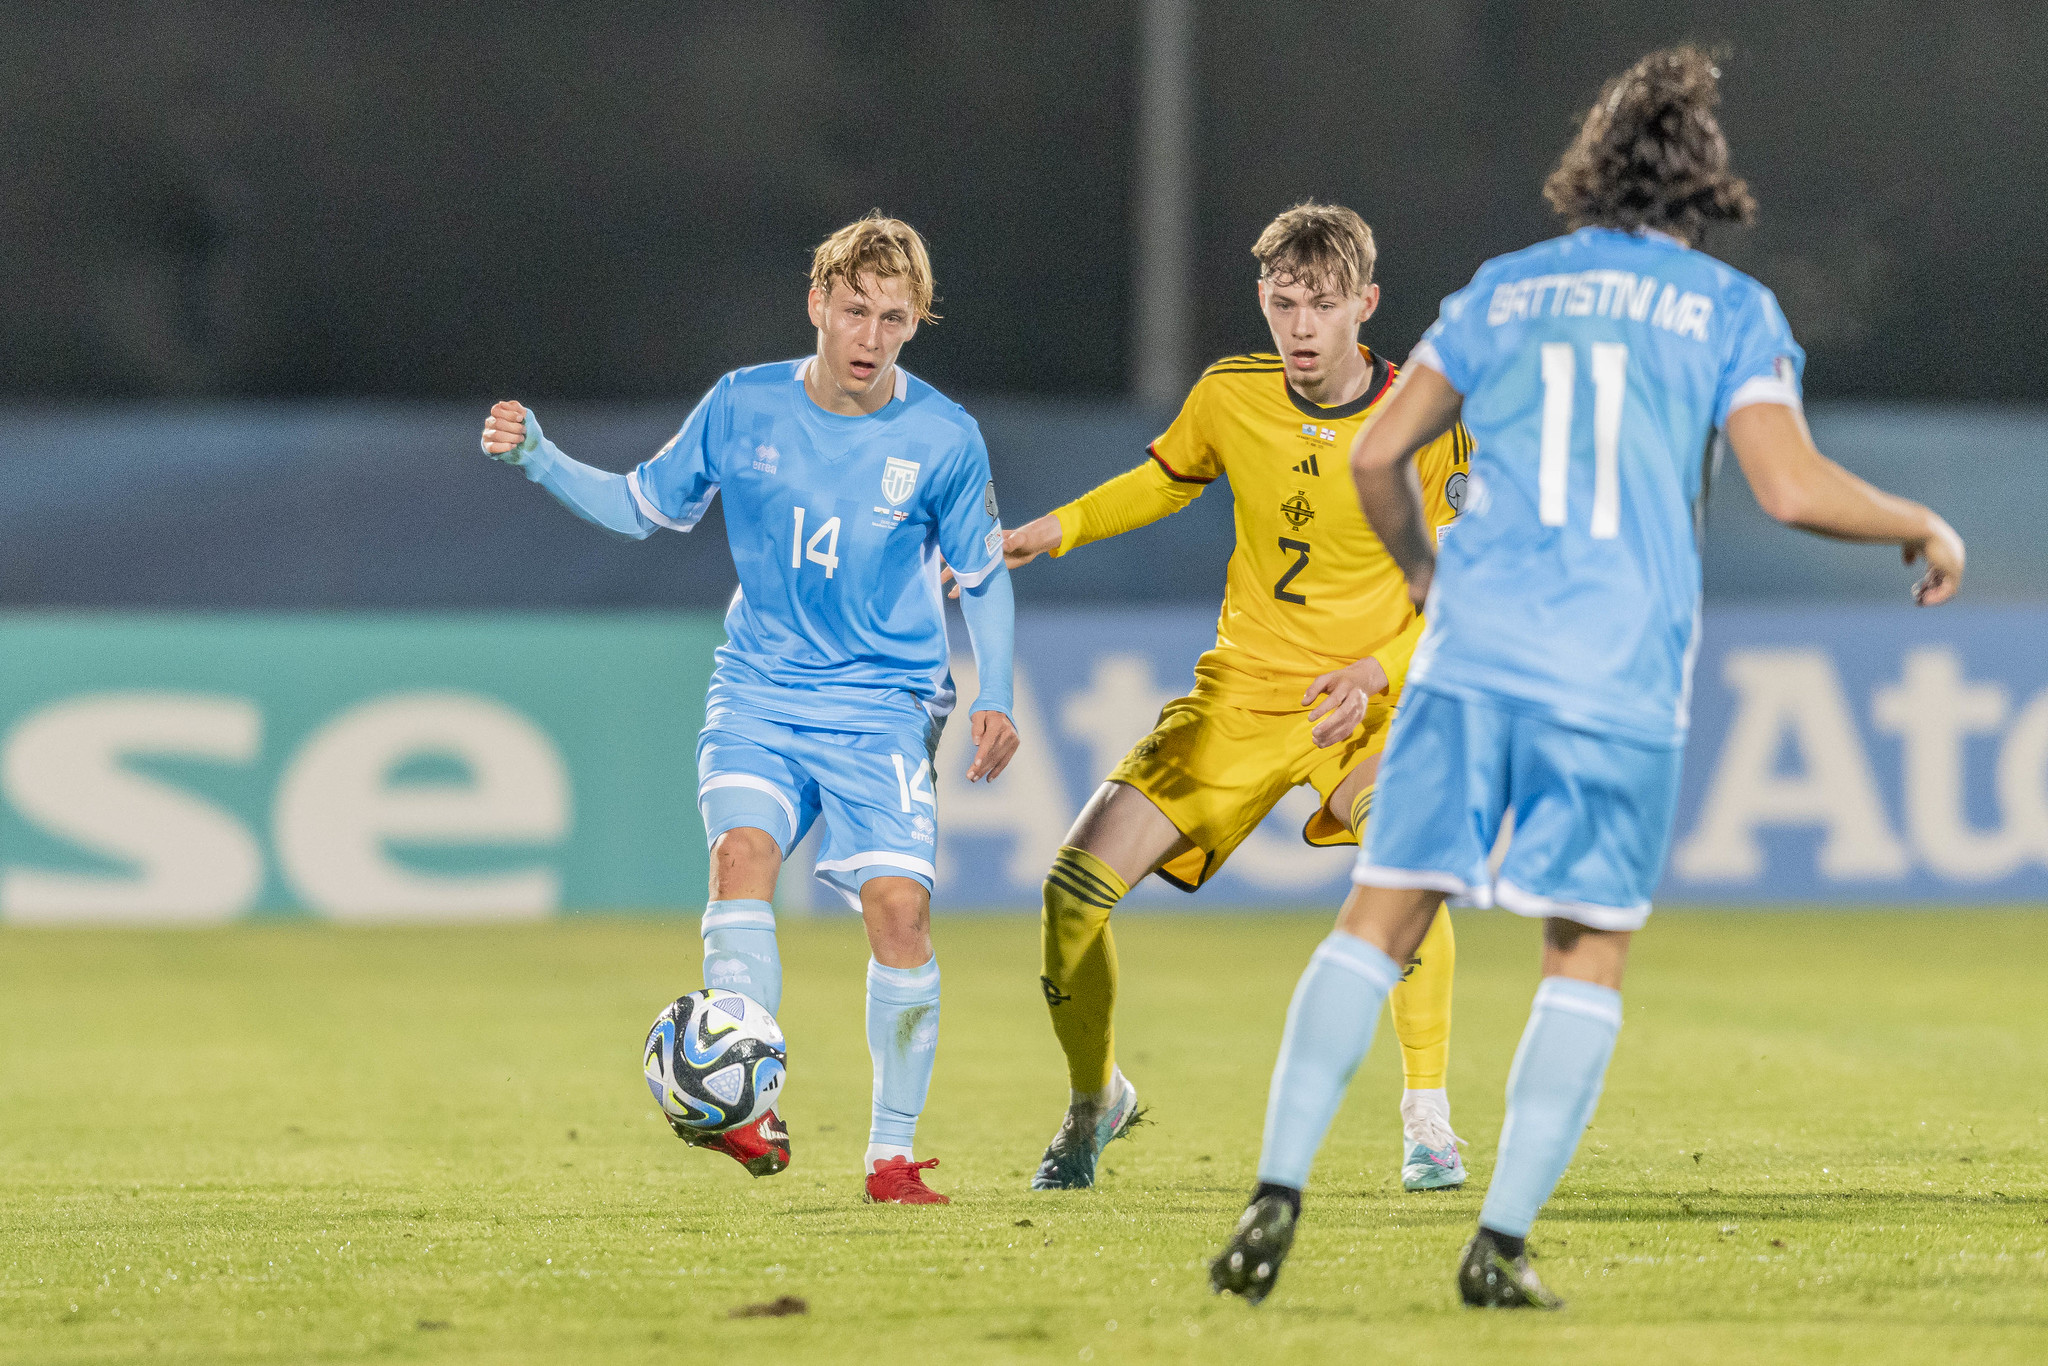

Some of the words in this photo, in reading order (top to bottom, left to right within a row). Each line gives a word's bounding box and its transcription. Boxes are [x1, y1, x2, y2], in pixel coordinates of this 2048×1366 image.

[1539, 342, 1628, 539] 11
[792, 506, 841, 579] 14
[1274, 536, 1310, 606] 2
[1, 689, 573, 924] se
[890, 754, 937, 821] 14
[1670, 644, 2048, 884] At
